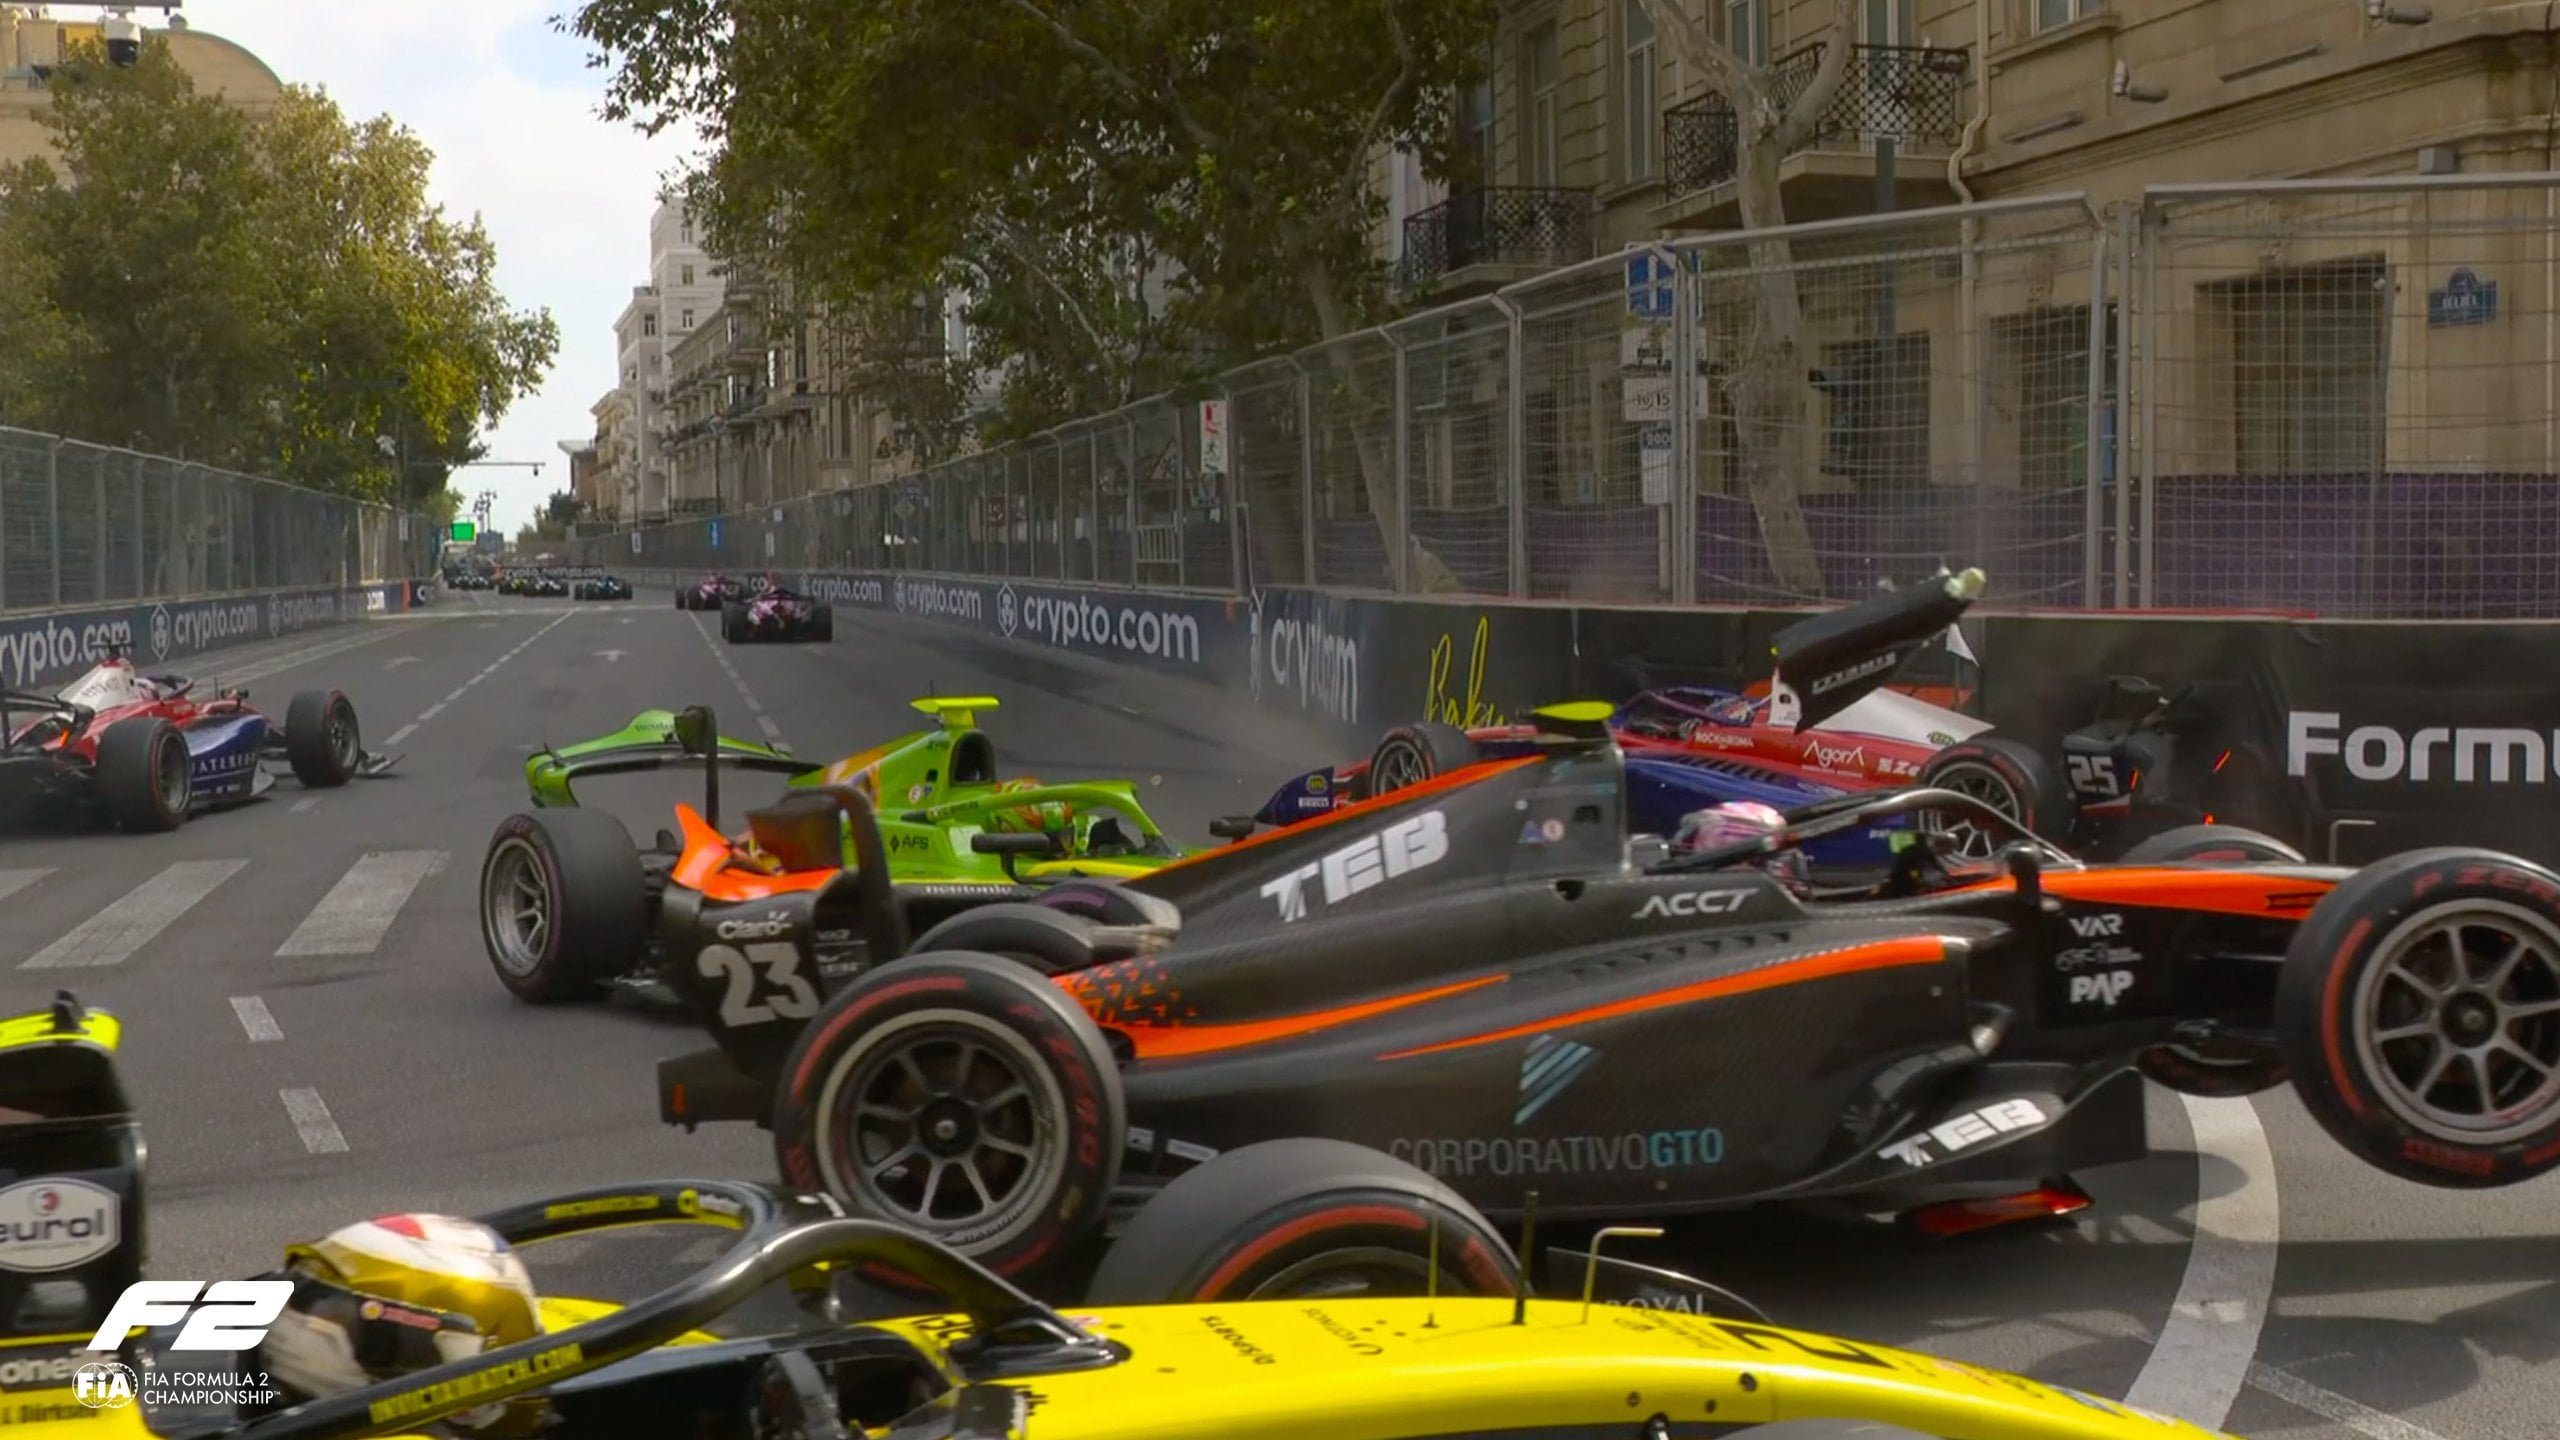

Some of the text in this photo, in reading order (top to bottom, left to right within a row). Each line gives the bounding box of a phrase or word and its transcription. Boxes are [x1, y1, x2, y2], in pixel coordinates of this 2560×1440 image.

[812, 577, 882, 603] crypto.com
[908, 581, 982, 620] crypto.com
[175, 602, 258, 650] crypto.com
[1024, 594, 1199, 662] crypto.com
[0, 619, 132, 688] rypto.com
[2288, 710, 2560, 784] Form
[2067, 754, 2119, 796] 25
[902, 837, 929, 850] AFS
[1259, 810, 1449, 923] TEB
[1631, 887, 1760, 919] ACCT
[2068, 913, 2123, 937] VAR
[698, 942, 820, 1027] 23
[1876, 1098, 2048, 1167] TEB
